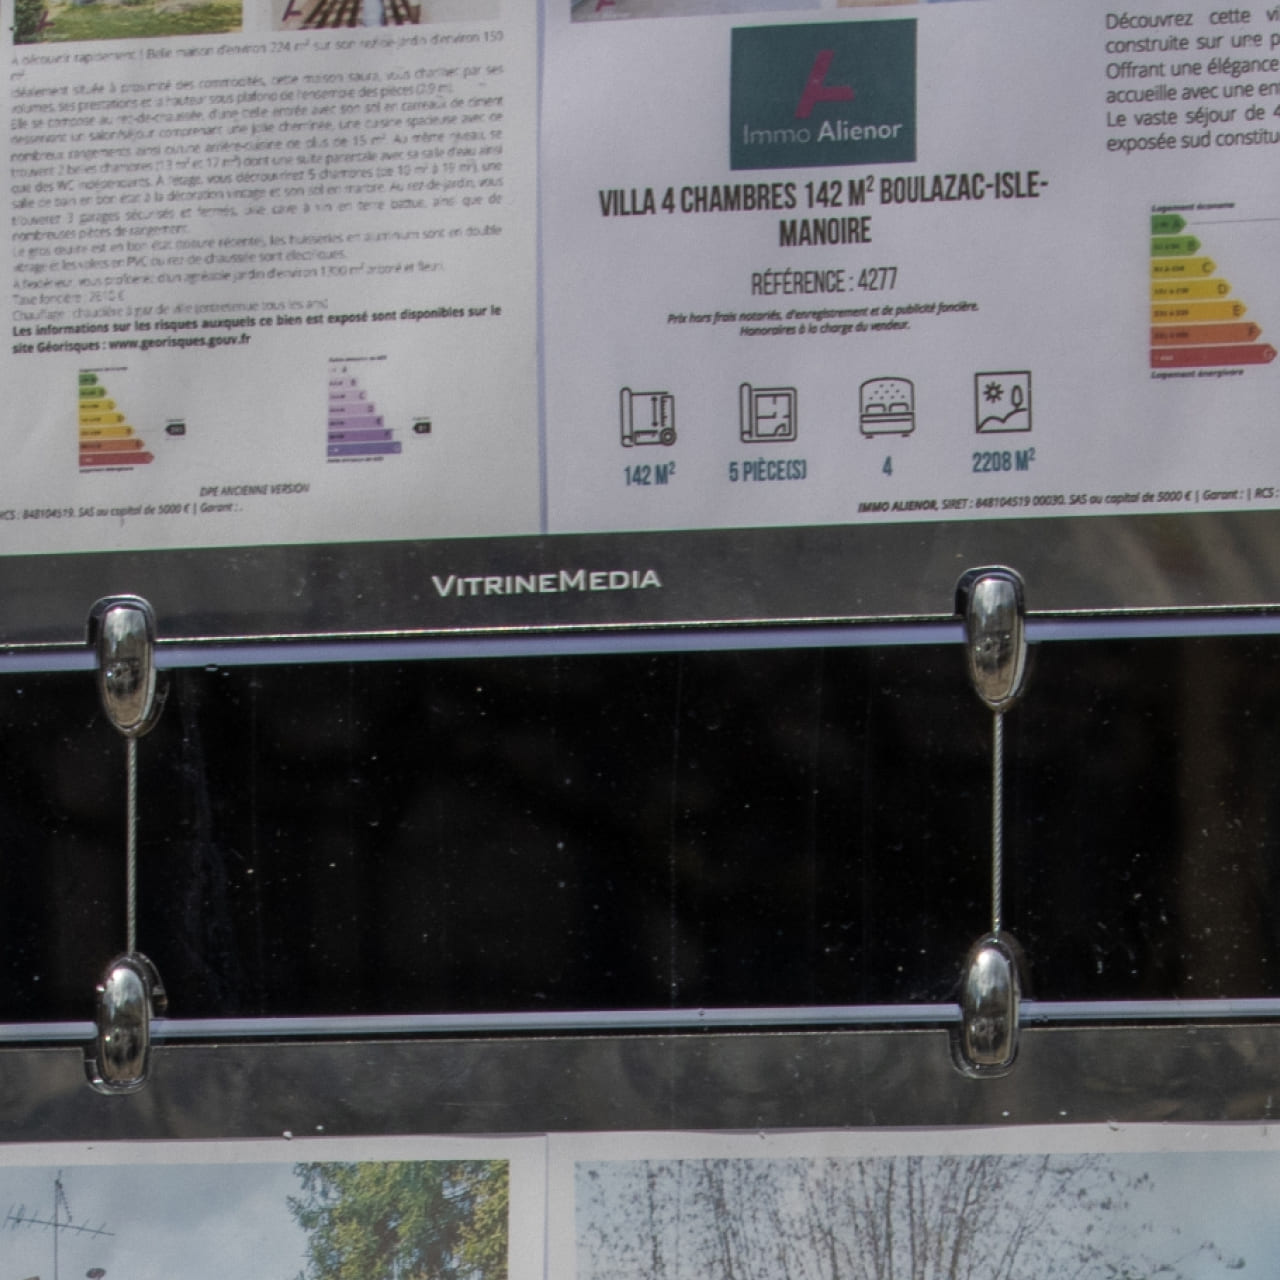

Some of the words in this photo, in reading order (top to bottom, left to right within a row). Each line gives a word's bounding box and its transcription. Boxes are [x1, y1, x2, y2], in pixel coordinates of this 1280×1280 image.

[743, 124, 811, 145] Immo
[816, 119, 904, 143] Alienor
[1105, 131, 1178, 156] exposée
[1180, 129, 1212, 150] sud
[598, 187, 657, 217] VILLA
[660, 186, 676, 215] 4
[679, 181, 797, 214] CHAMBRES
[804, 179, 843, 209] 142
[879, 170, 1049, 205] BOULAZAC-ISLE-
[778, 215, 873, 248] MANOIRE
[11, 342, 35, 355] site
[35, 340, 101, 355] Géorisques
[107, 332, 252, 352] www.georisques.gouv.fr
[728, 461, 740, 483] 5
[742, 456, 808, 483] PIÈCE(S)
[971, 450, 1013, 474] 2208
